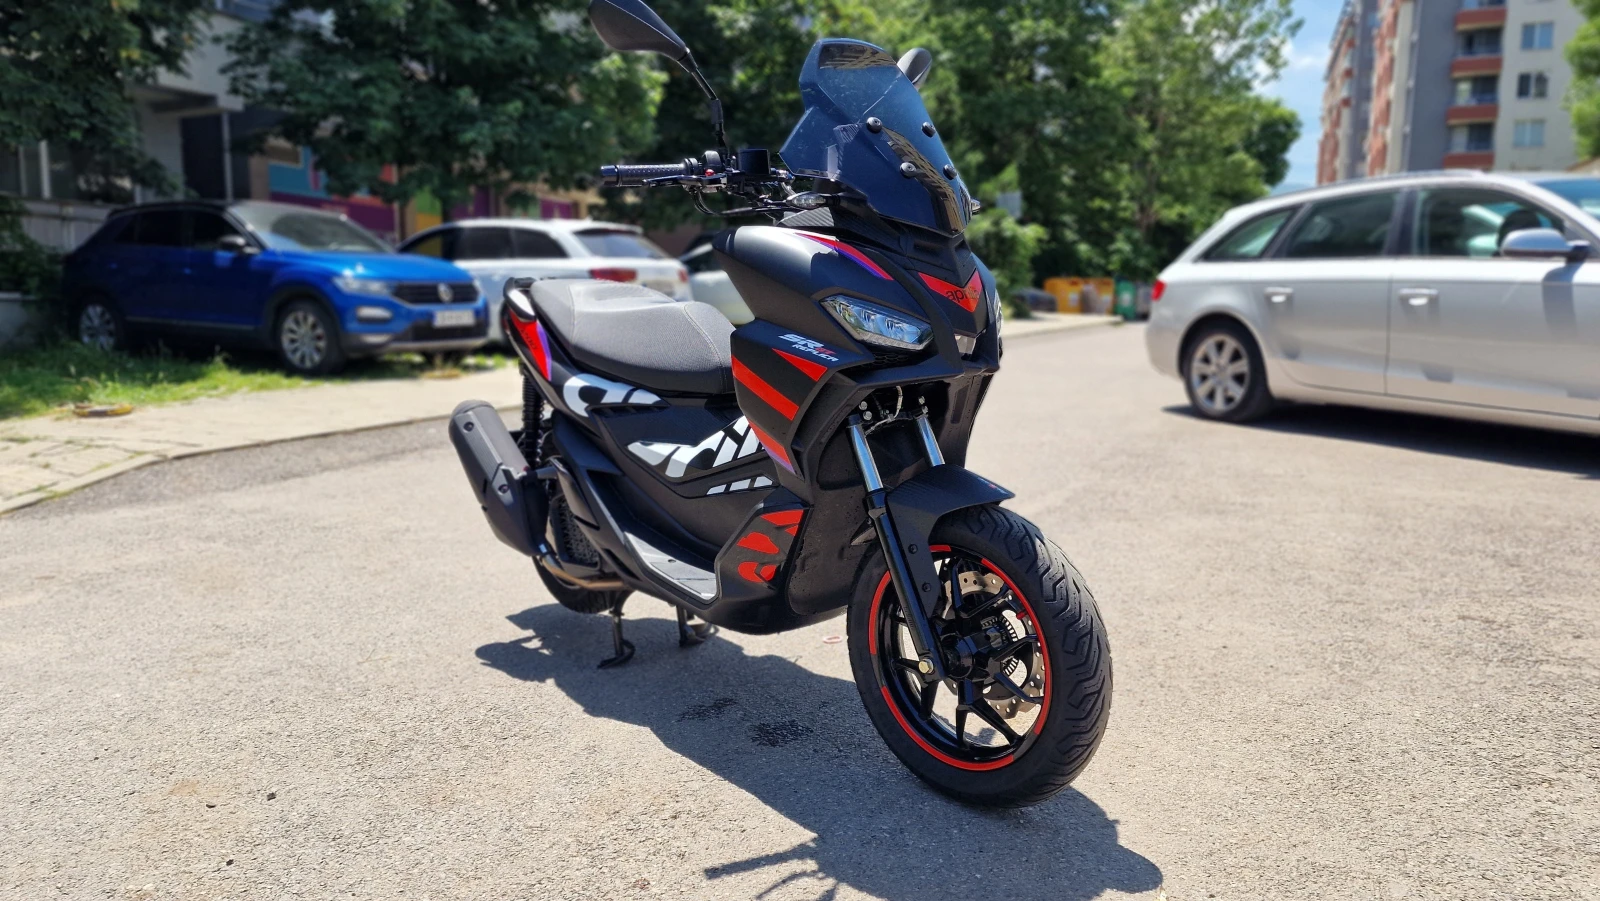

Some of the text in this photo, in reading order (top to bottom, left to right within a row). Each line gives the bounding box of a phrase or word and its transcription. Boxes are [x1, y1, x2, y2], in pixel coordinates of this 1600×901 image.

[945, 285, 979, 303] apra
[778, 333, 824, 348] SR
[792, 344, 839, 362] REPLICA
